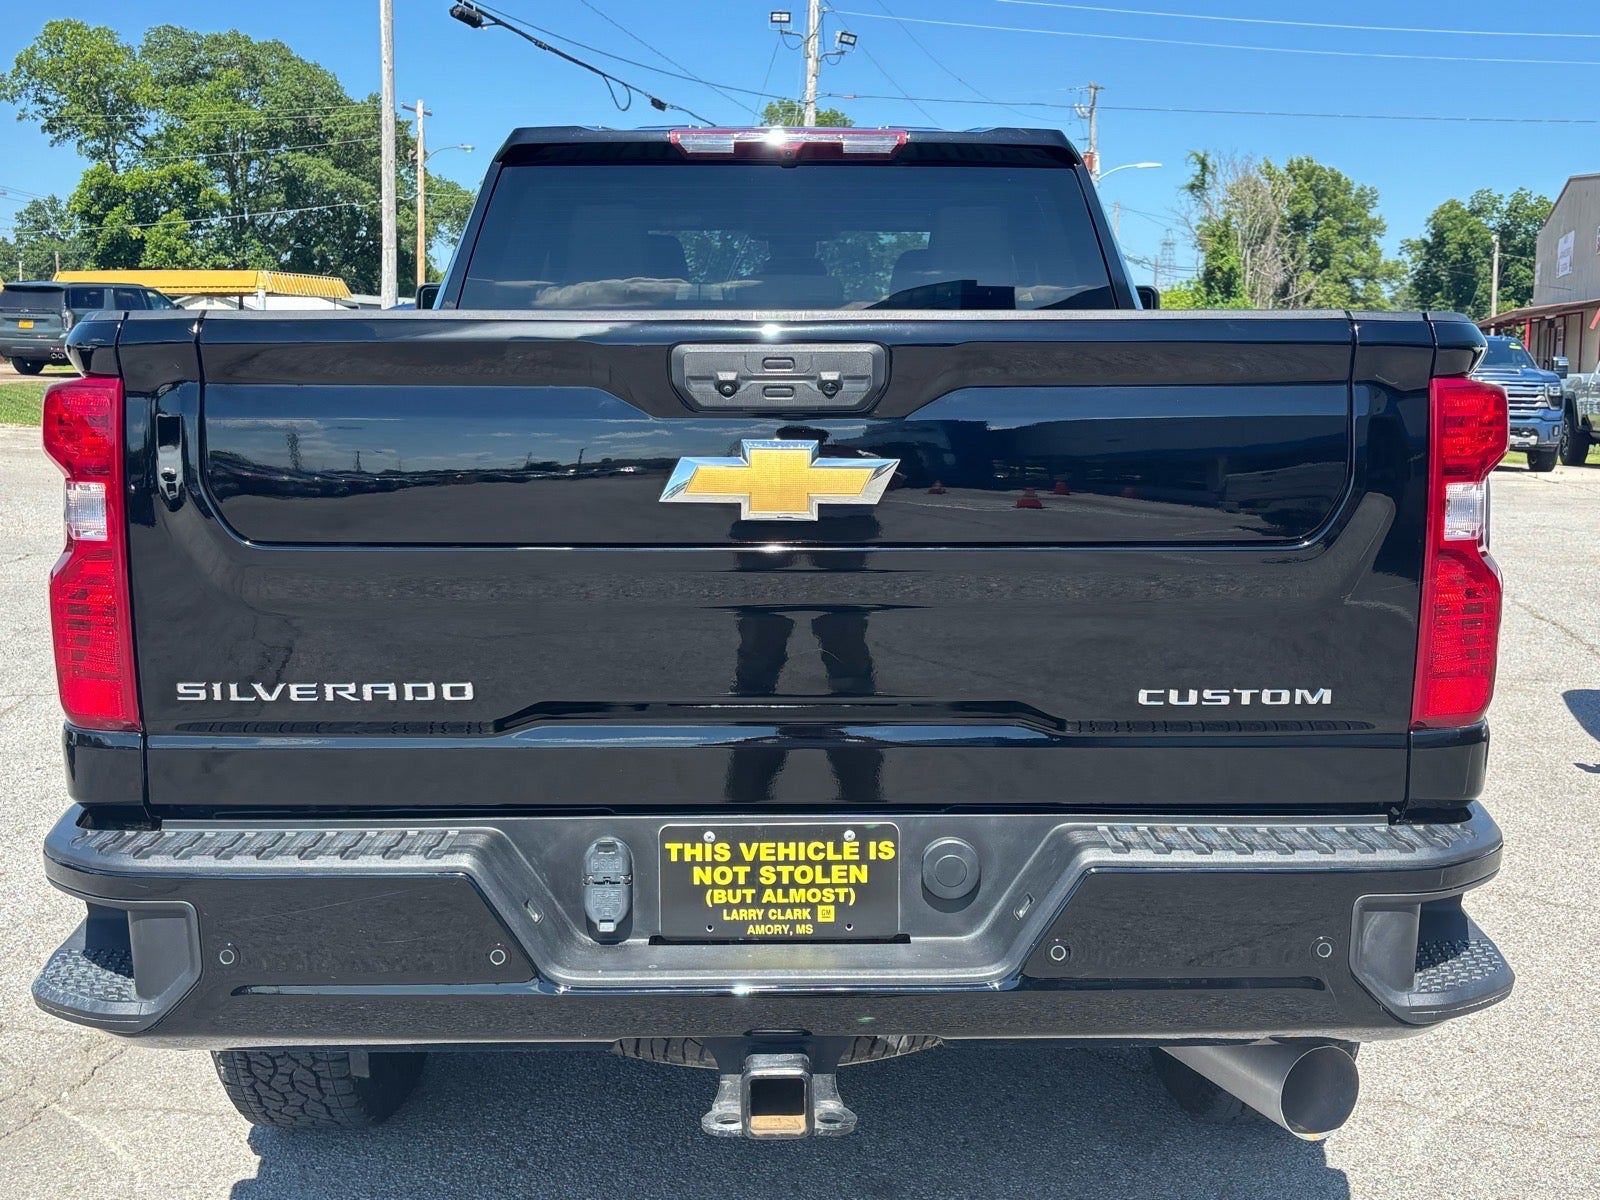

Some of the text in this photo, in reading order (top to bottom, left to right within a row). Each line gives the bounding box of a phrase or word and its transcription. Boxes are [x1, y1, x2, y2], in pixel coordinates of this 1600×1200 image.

[176, 682, 474, 701] SILVERADO
[1138, 688, 1333, 705] CUSTOM
[664, 840, 896, 862] THIS VEHICLE IS
[693, 864, 868, 885] NOT STOLEN
[705, 887, 856, 907] (BUT ALMOST)
[723, 908, 811, 921] LARRY CLARK
[747, 923, 814, 936] AMORY, MS
